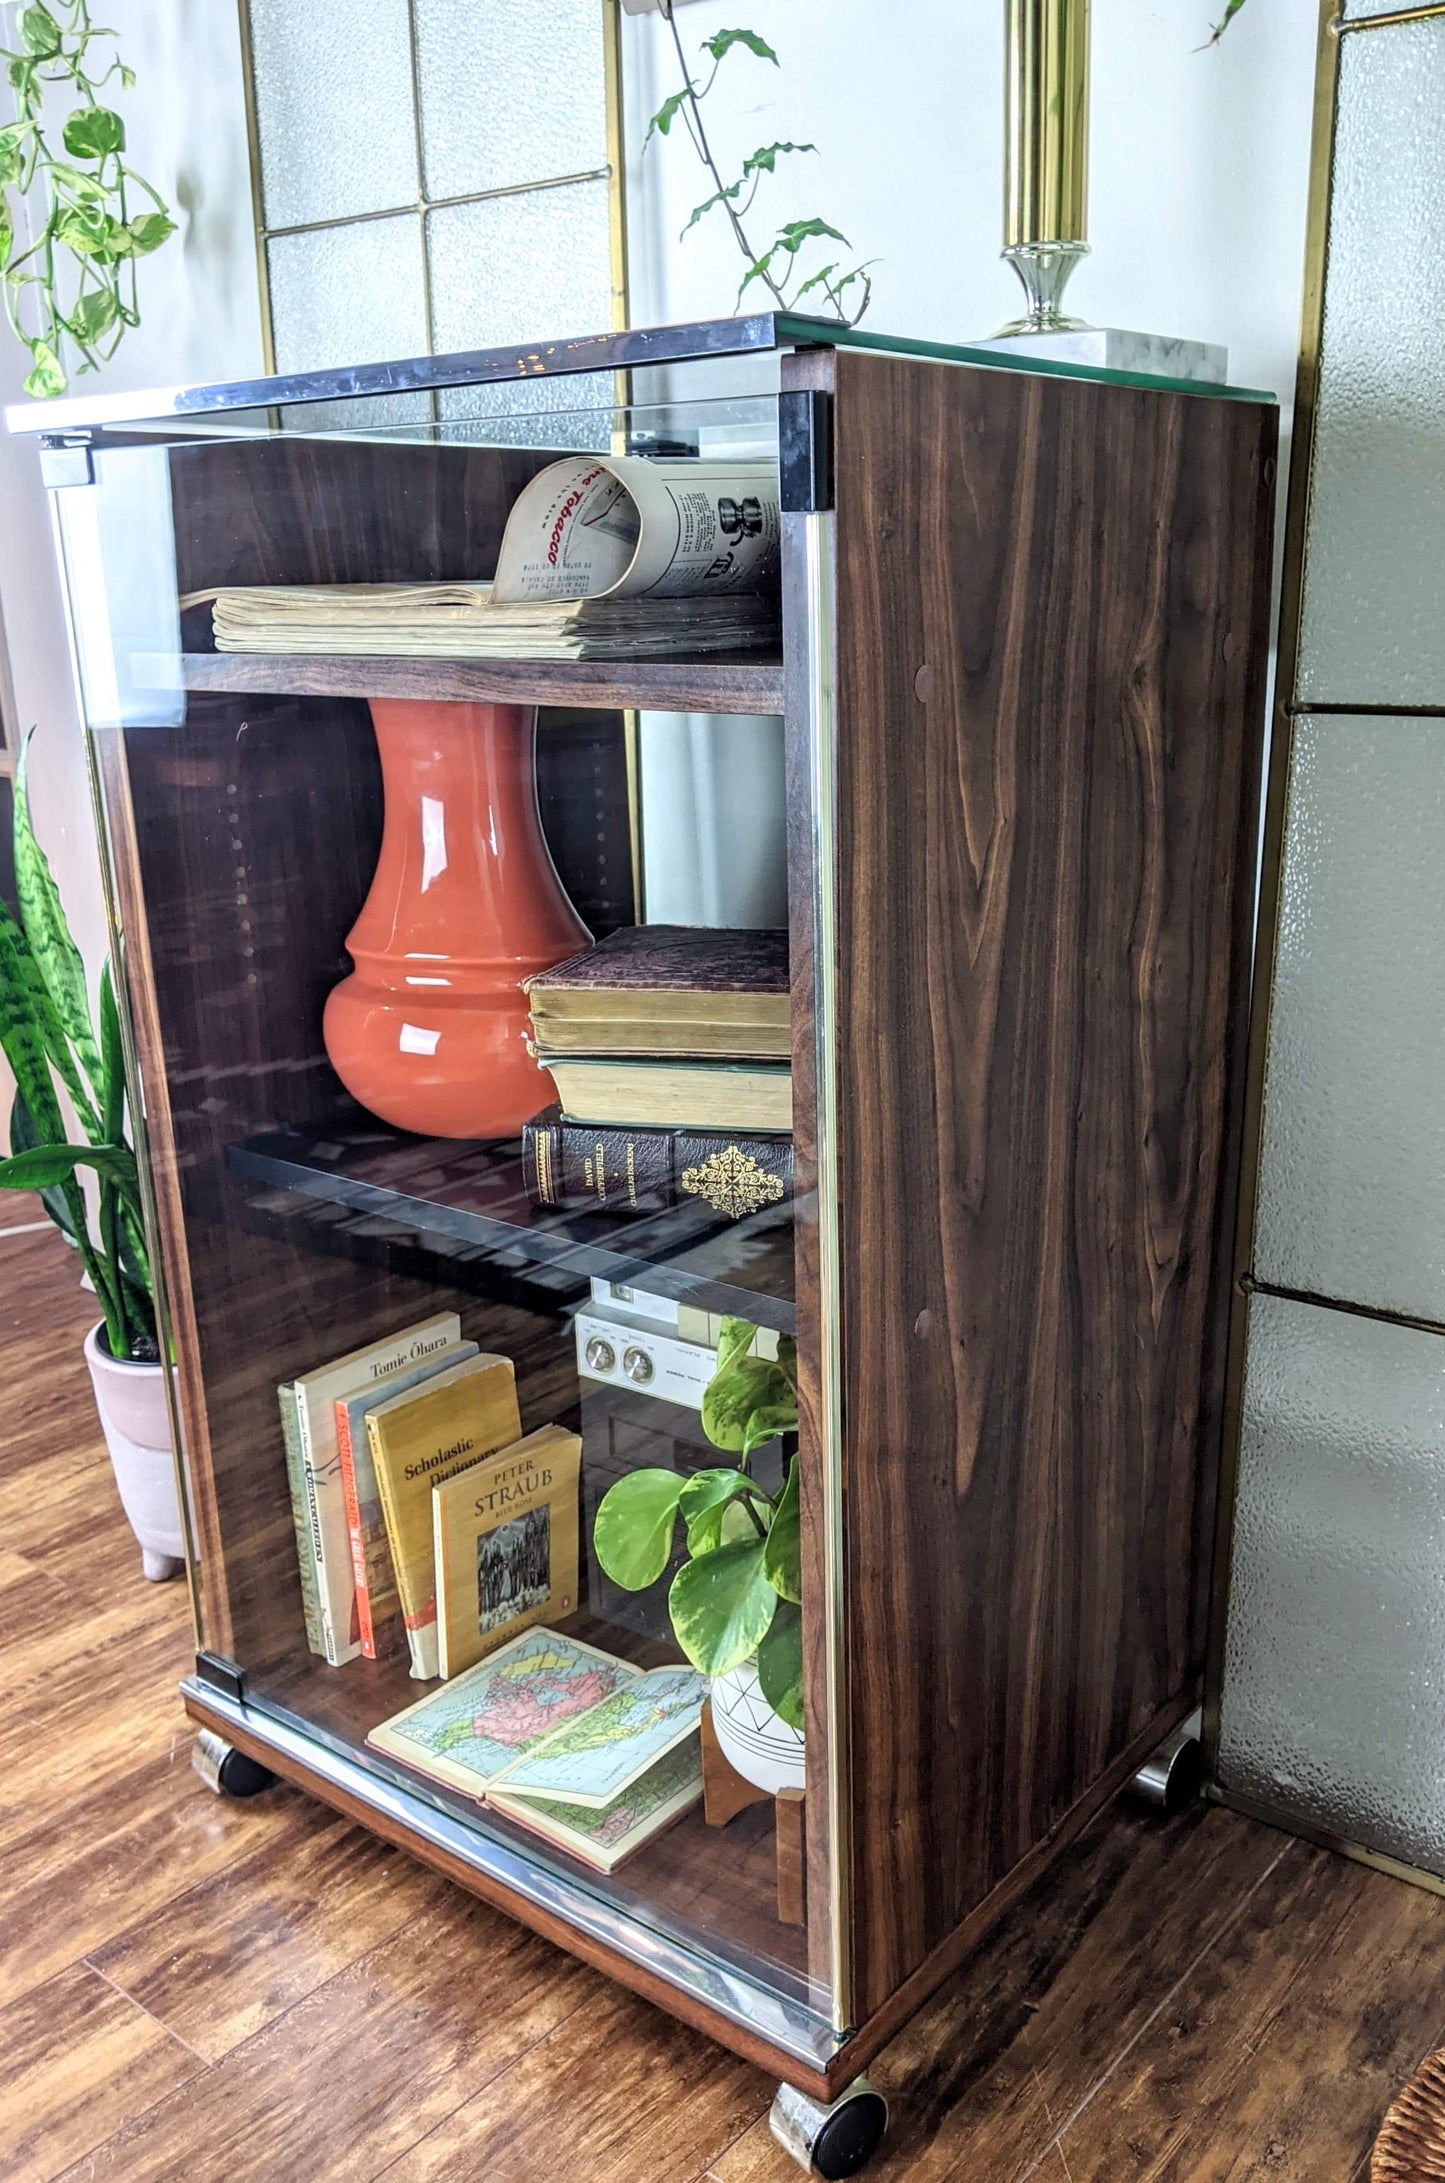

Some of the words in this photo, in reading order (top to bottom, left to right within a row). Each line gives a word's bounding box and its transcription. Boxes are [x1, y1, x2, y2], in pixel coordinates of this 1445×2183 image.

[548, 490, 584, 566] Tobacco
[584, 1157, 594, 1187] DAVID
[595, 1143, 607, 1201] COPPERFIELD
[626, 1142, 635, 1175] DICKENS
[627, 1175, 638, 1207] CHARLES
[370, 1353, 408, 1378] Tomie
[338, 1424, 351, 1458] SCOTT
[404, 1438, 474, 1481] Scholastic
[494, 1460, 535, 1485] PETER
[343, 1463, 358, 1525] FITZGERALD
[474, 1468, 553, 1517] STRAUB
[351, 1540, 363, 1561] GREAT
[353, 1562, 366, 1588] GATSBY
